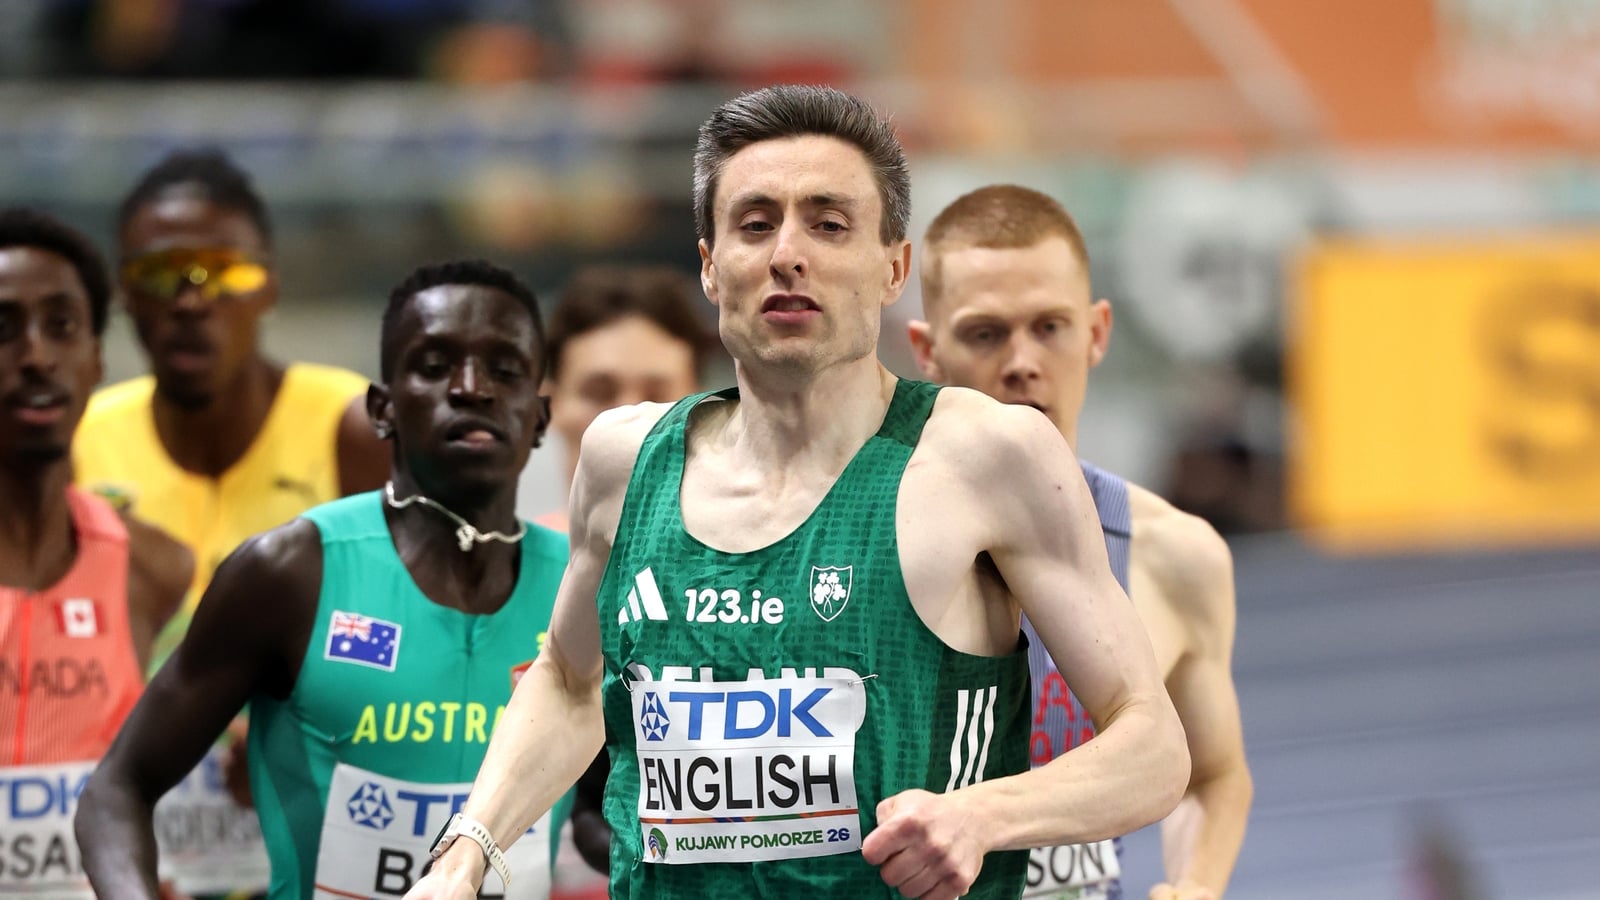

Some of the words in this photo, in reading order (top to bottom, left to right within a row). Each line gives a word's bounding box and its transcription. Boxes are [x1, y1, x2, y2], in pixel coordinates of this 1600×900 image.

[685, 588, 785, 624] 123.ie
[669, 687, 835, 741] TDK
[643, 754, 840, 811] ENGLISH
[675, 834, 737, 852] KUJAWY
[740, 829, 823, 849] POMORZE
[827, 827, 850, 843] 26
